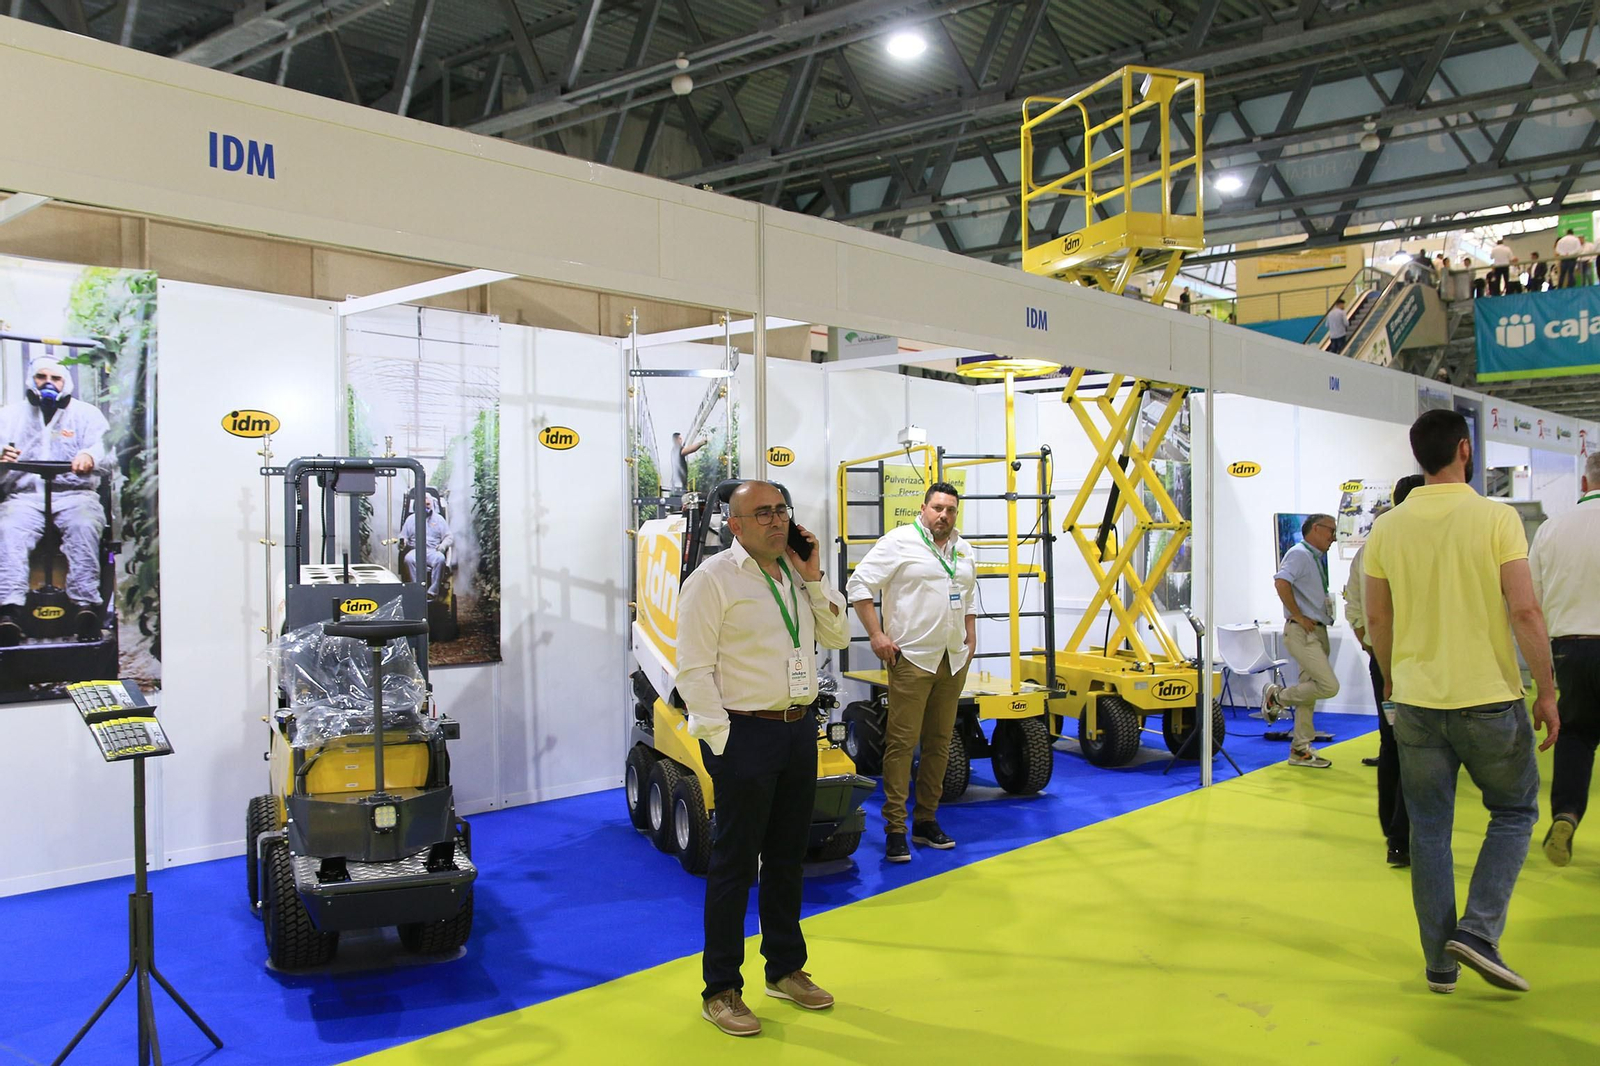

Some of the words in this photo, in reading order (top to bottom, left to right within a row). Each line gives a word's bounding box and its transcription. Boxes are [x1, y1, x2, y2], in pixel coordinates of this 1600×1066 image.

[209, 131, 275, 180] IDM
[1064, 237, 1080, 252] idm
[1026, 306, 1048, 331] IDM
[1543, 309, 1600, 344] caja
[1329, 375, 1340, 391] IDM
[231, 410, 270, 431] idm
[545, 427, 573, 445] idm
[769, 447, 790, 462] idm
[1232, 462, 1255, 474] idm
[1342, 482, 1360, 491] idm
[894, 507, 921, 517] Efficien
[37, 606, 61, 617] idm
[345, 600, 372, 612] idm
[1158, 681, 1187, 697] idm
[1012, 701, 1027, 710] idm
